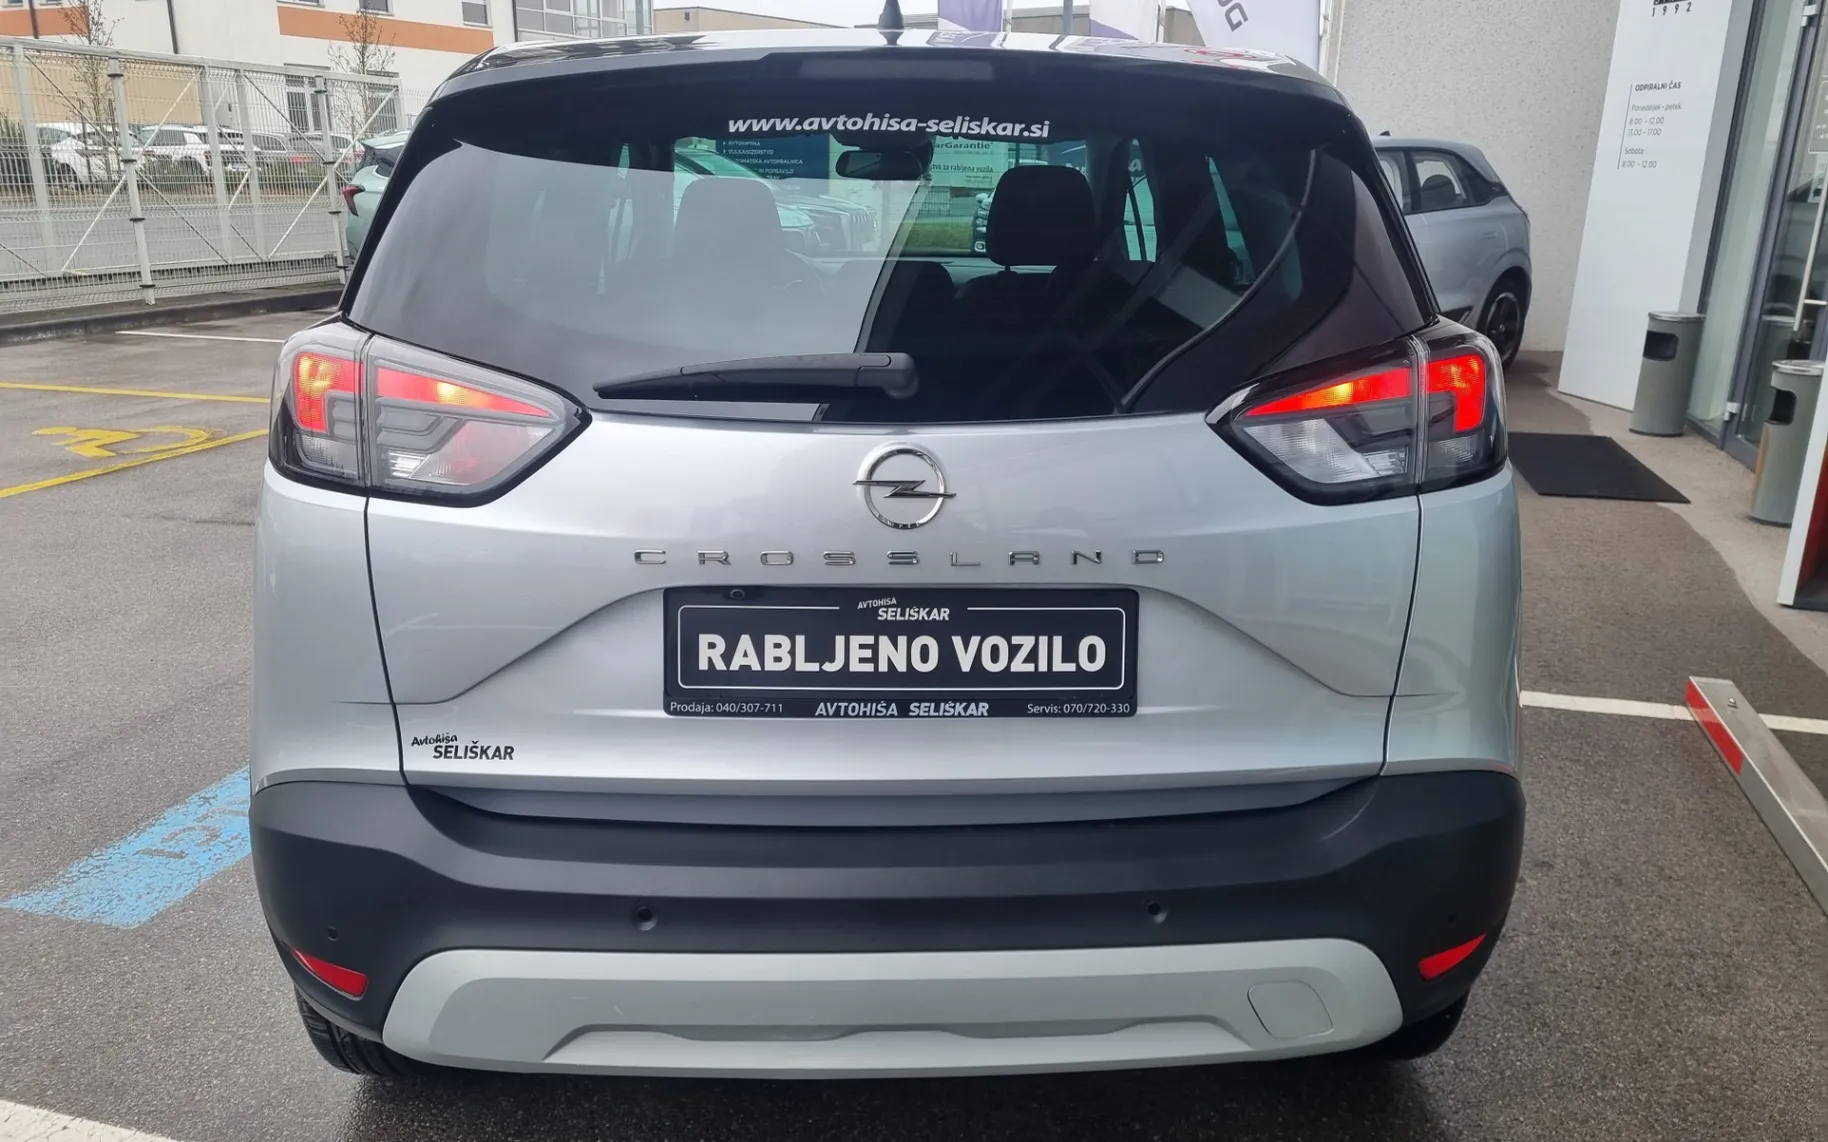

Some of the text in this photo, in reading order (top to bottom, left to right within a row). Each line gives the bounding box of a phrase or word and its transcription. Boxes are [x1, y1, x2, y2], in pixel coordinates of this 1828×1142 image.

[1651, 2, 1692, 17] 1992
[1635, 80, 1682, 92] ODPIRALNI ČAS
[728, 112, 1050, 138] www.avtohisa-seliskar.si
[935, 141, 990, 149] arGarantie
[634, 548, 1167, 567] CROSSLAND
[877, 606, 950, 621] SELIŠKAR
[698, 633, 1107, 673] RABLJENO VOZILO
[670, 702, 784, 716] Prodaja: 040/307-711
[815, 700, 990, 717] AVTOHIŠA SELIŠKAR
[1027, 703, 1131, 716] Servis: 070/720-330
[432, 740, 515, 760] SELIŠKAR
